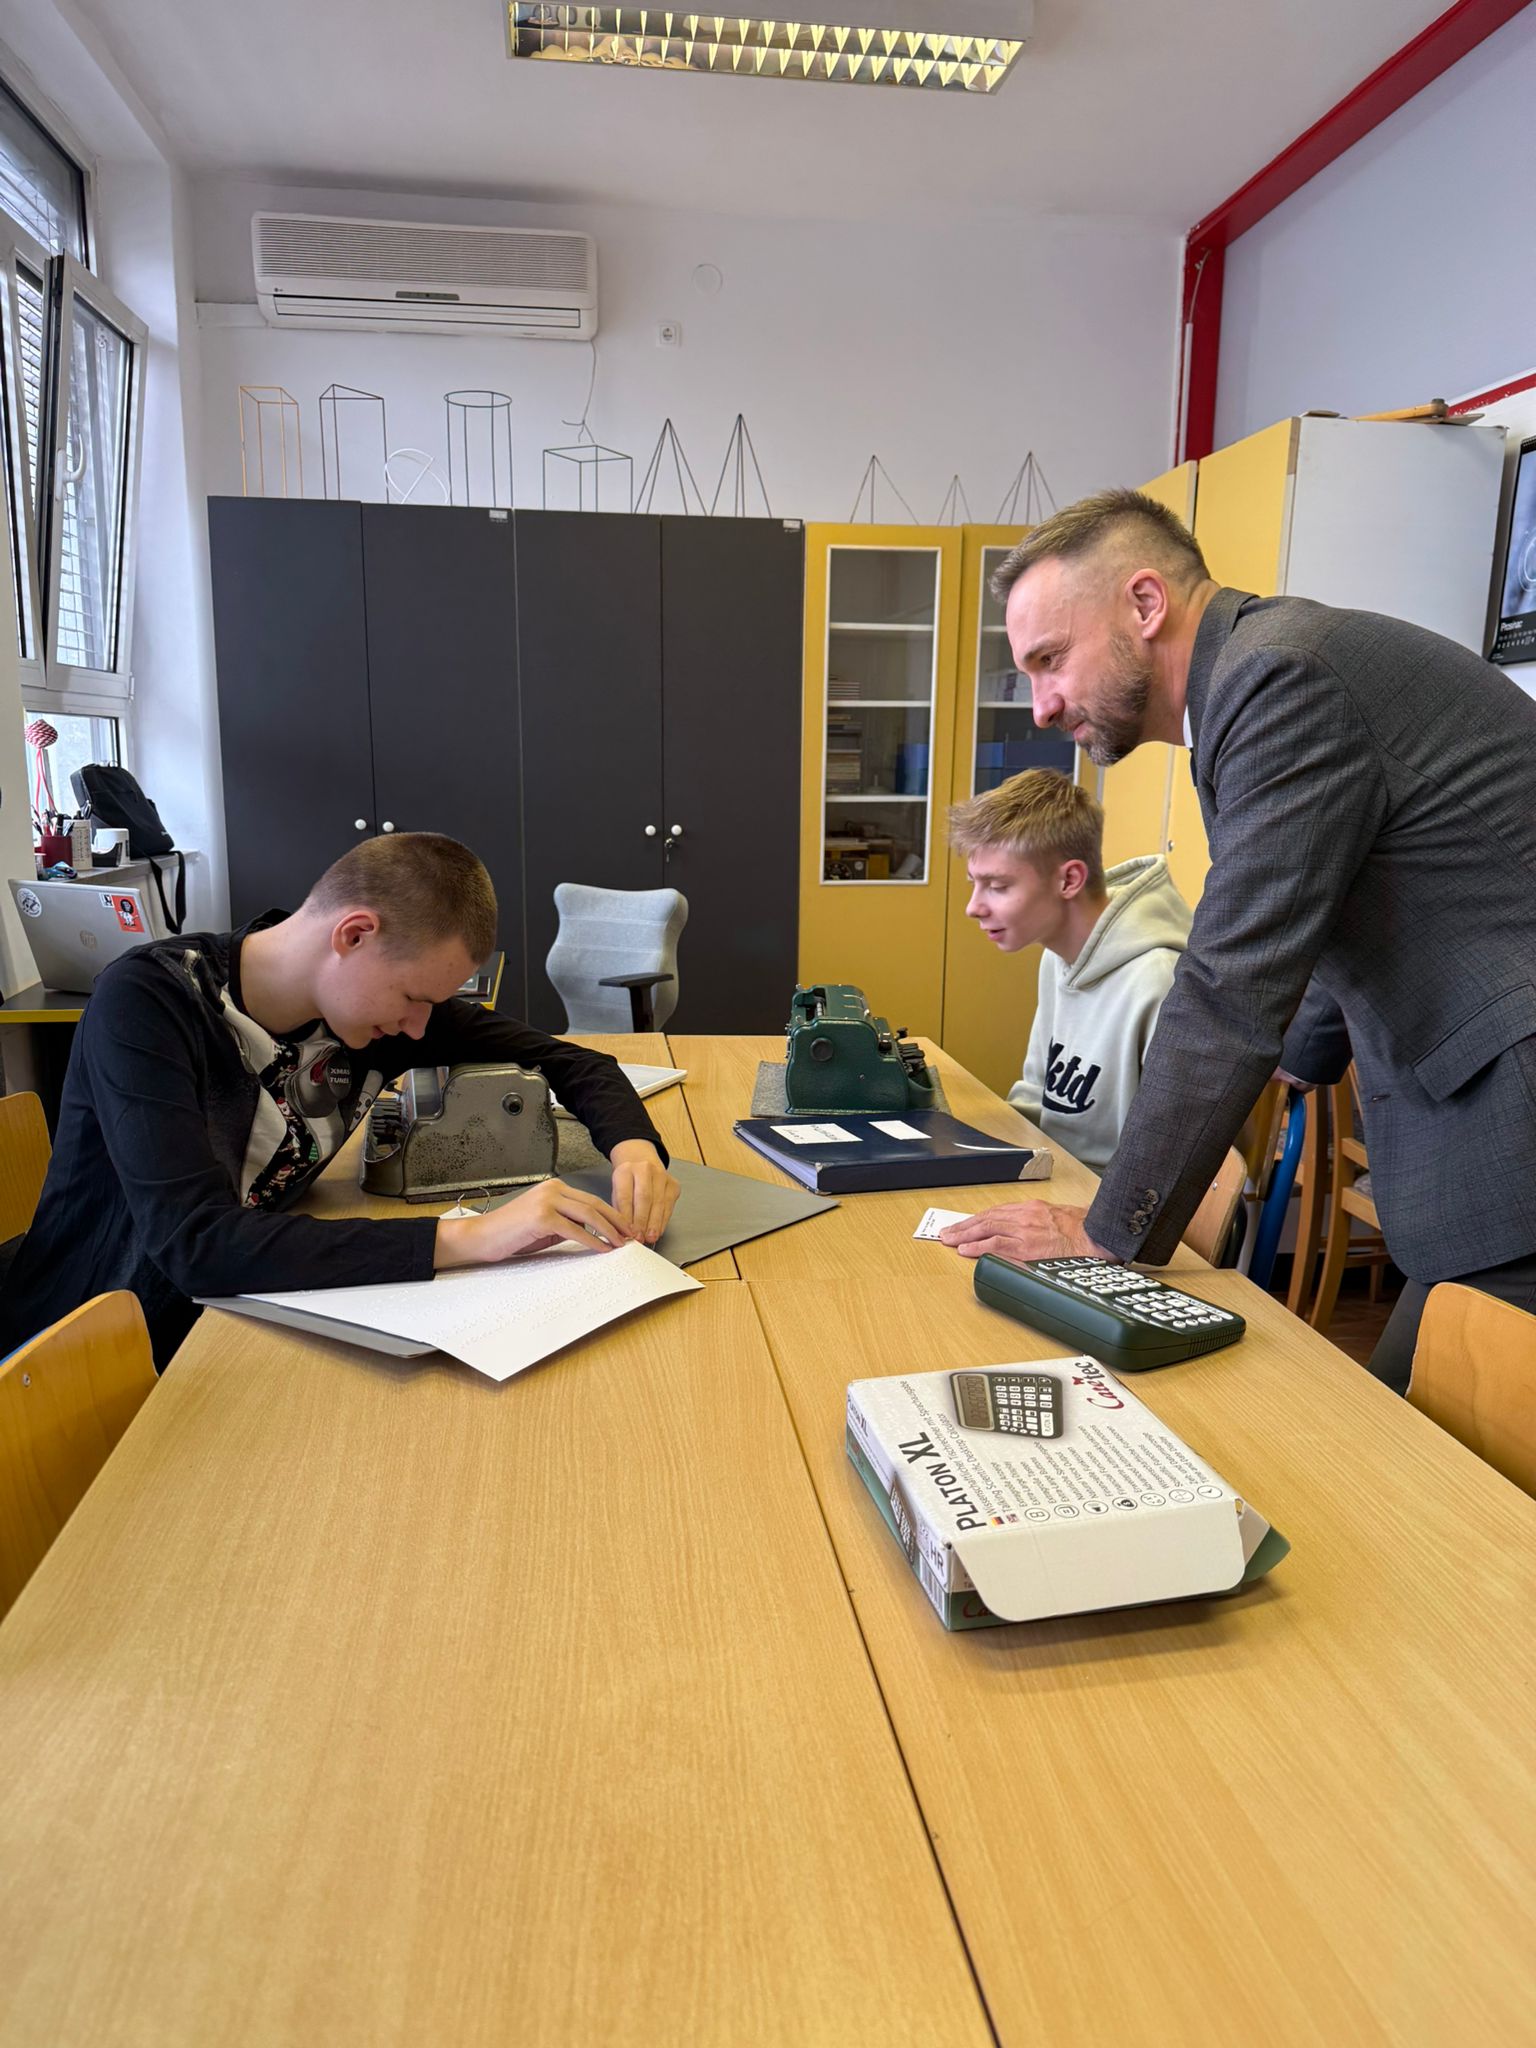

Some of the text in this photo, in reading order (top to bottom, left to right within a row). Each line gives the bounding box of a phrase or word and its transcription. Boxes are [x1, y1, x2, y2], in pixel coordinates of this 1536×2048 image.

[1042, 1036, 1102, 1114] ktd
[935, 1412, 960, 1439] Calculator
[897, 1431, 941, 1464] XL
[930, 1426, 959, 1461] Tischrechner
[955, 1438, 977, 1463] Desktop
[953, 1460, 998, 1516] Wissenschaftlicher
[971, 1462, 997, 1490] Scientific
[925, 1462, 988, 1531] PLATON
[991, 1489, 1013, 1513] Talking
[930, 1540, 945, 1577] HR
